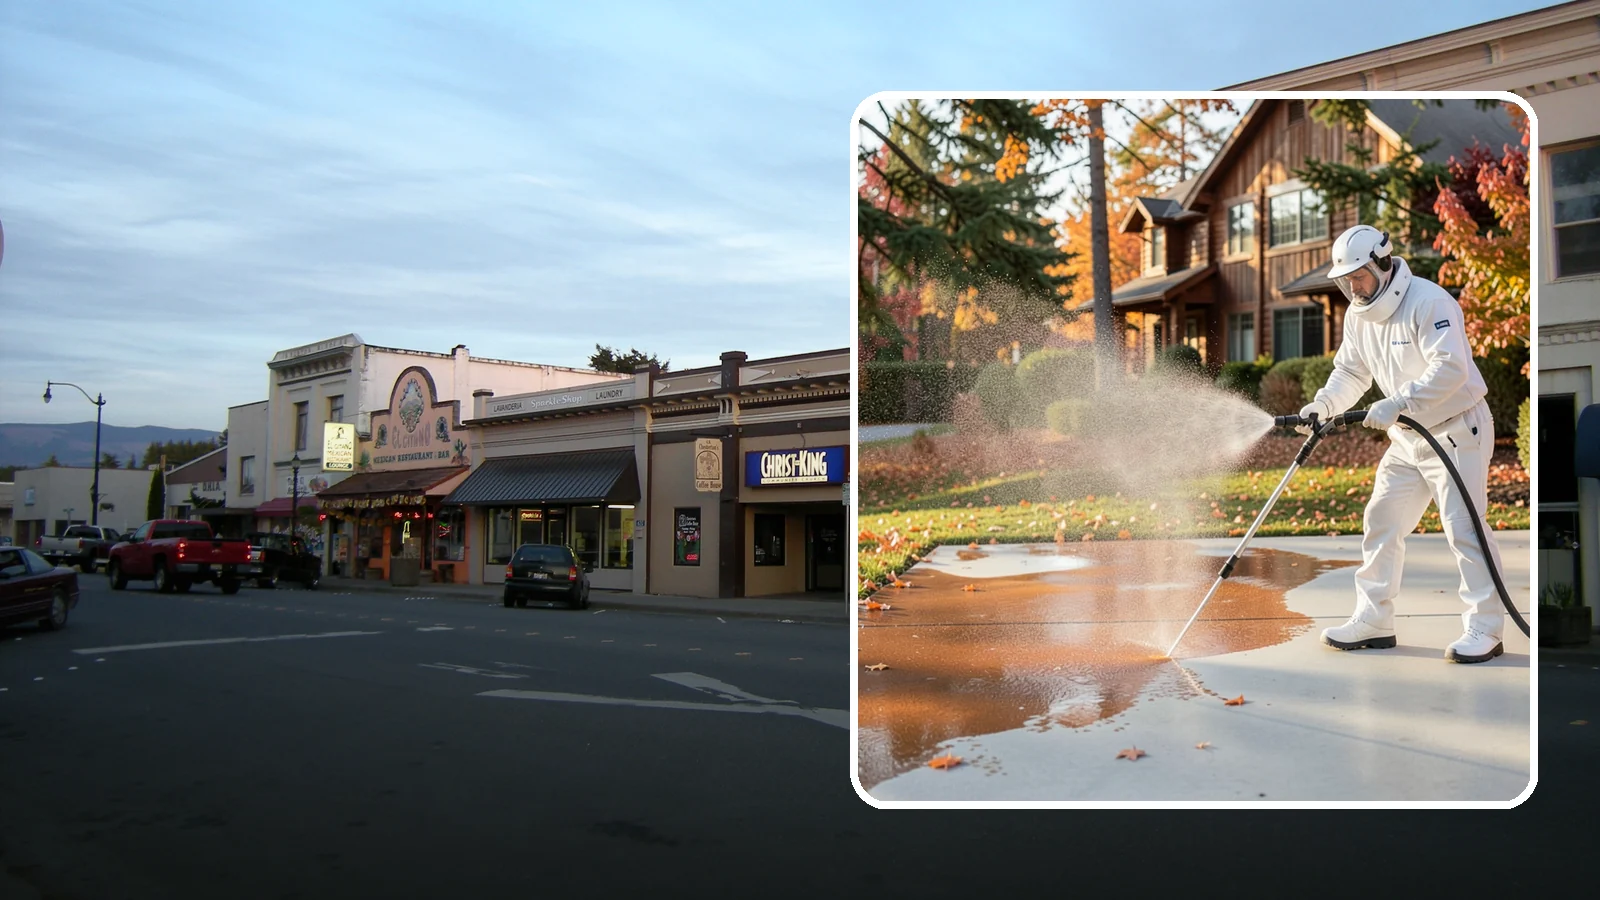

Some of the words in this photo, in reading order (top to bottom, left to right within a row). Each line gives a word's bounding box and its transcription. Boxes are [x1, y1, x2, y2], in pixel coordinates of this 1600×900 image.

[531, 396, 561, 409] Sparkle
[561, 394, 583, 404] Shop
[595, 388, 624, 400] LAUNDRY
[493, 402, 522, 412] LAVANDERIA
[392, 425, 402, 449] EL
[373, 454, 396, 465] MEXICAN
[397, 451, 434, 463] RESTAURANT
[437, 450, 450, 460] BAR
[761, 452, 797, 478] CHRIST
[799, 450, 827, 476] KING
[696, 481, 709, 489] Coffee
[709, 481, 722, 489] House
